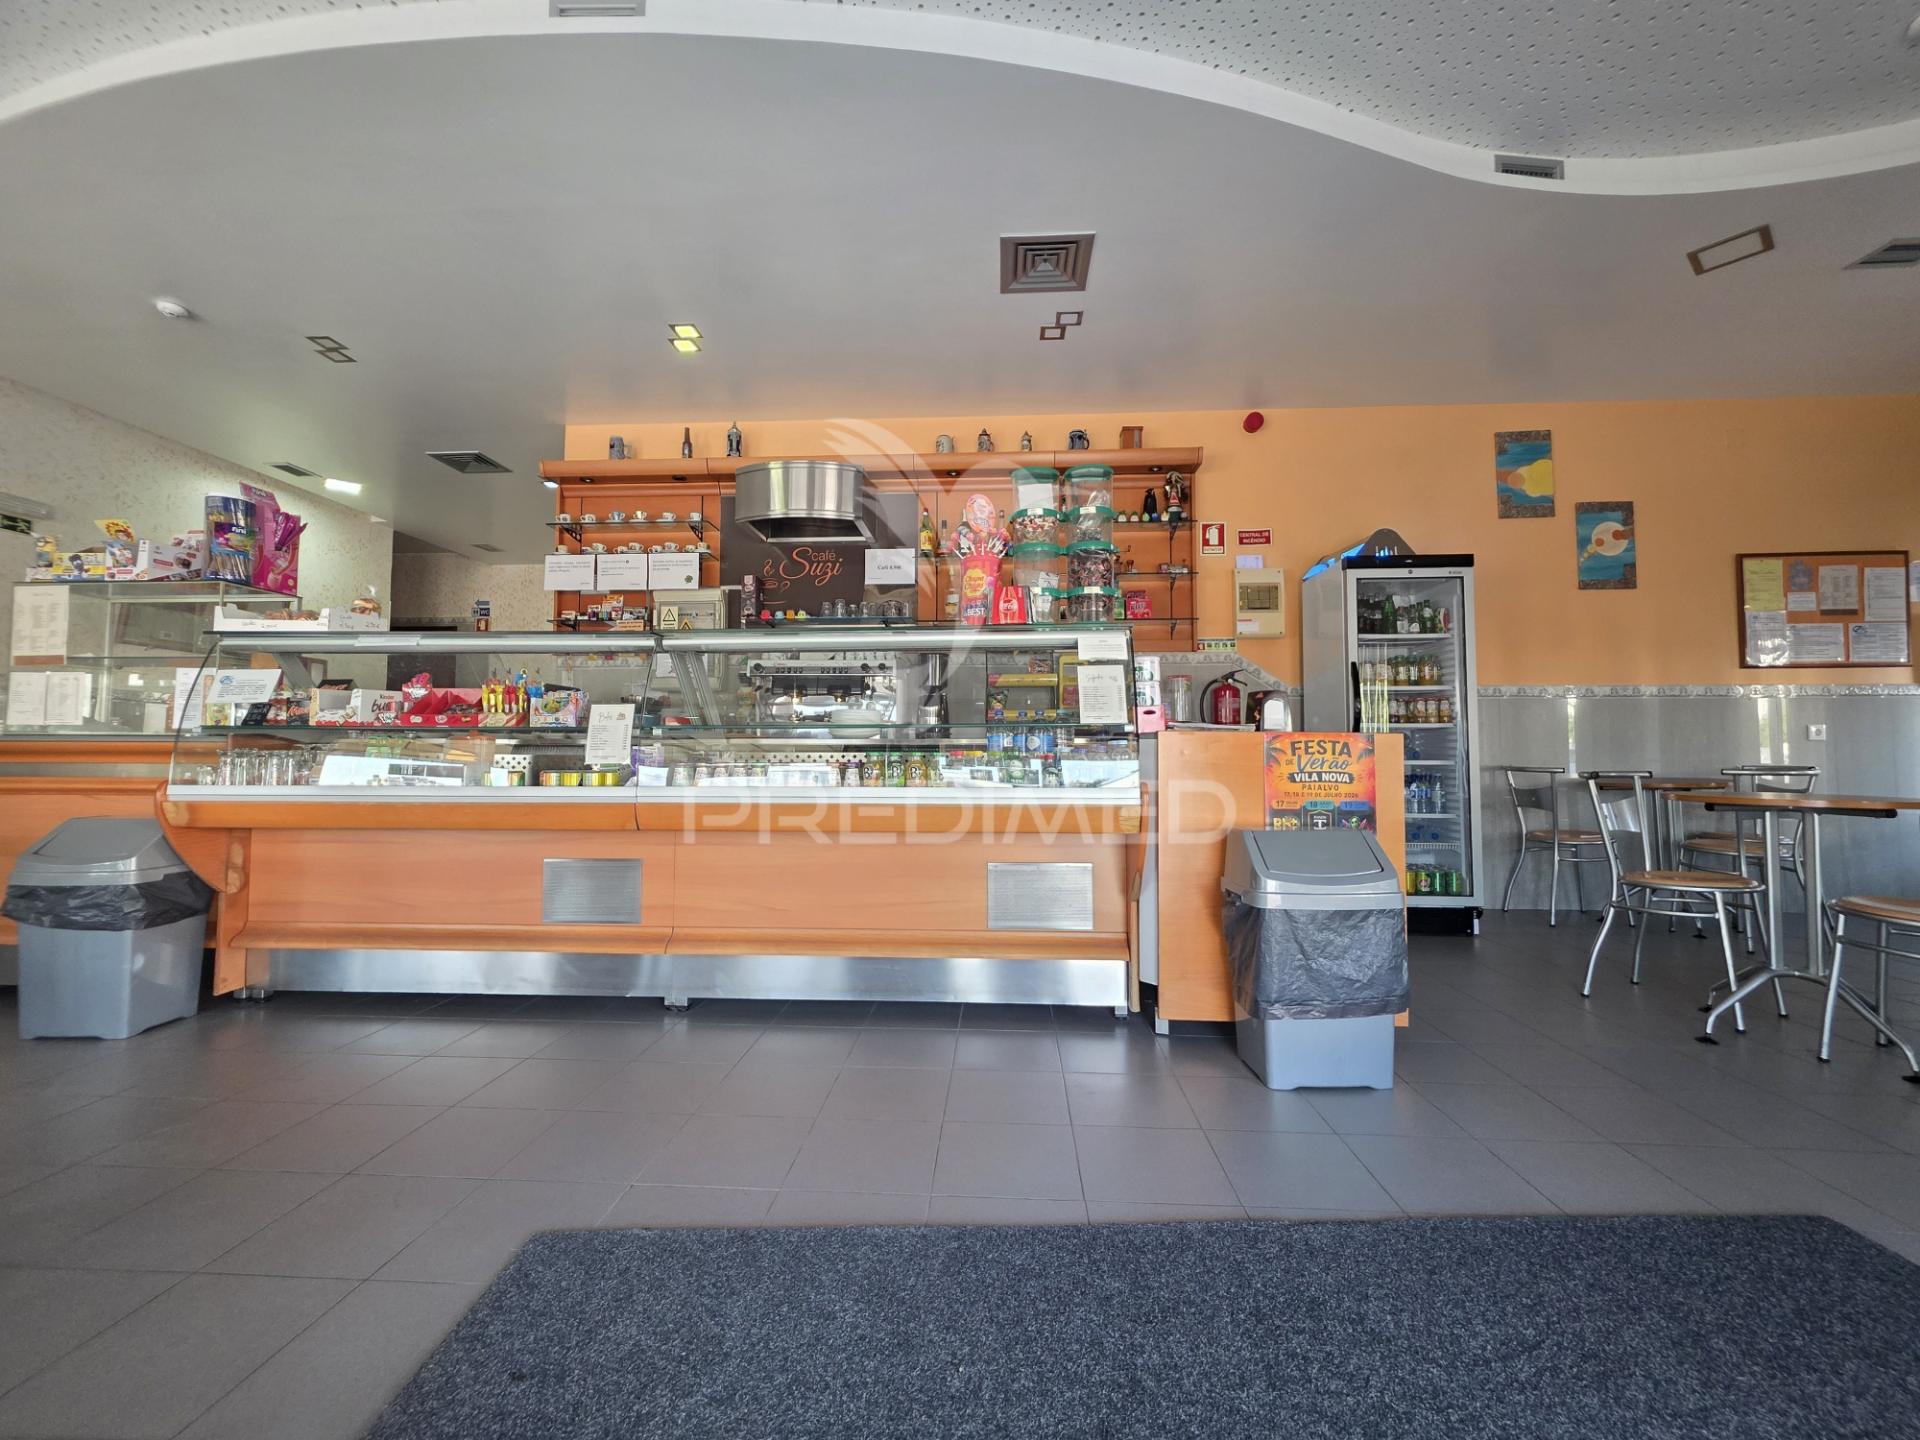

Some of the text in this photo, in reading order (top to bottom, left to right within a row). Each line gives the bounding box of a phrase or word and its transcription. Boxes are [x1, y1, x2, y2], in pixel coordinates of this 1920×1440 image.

[811, 551, 836, 561] café
[779, 546, 844, 586] Suzi
[1290, 740, 1352, 758] FESTA
[1296, 753, 1352, 773] Verão
[1293, 772, 1350, 783] VILA NOVA
